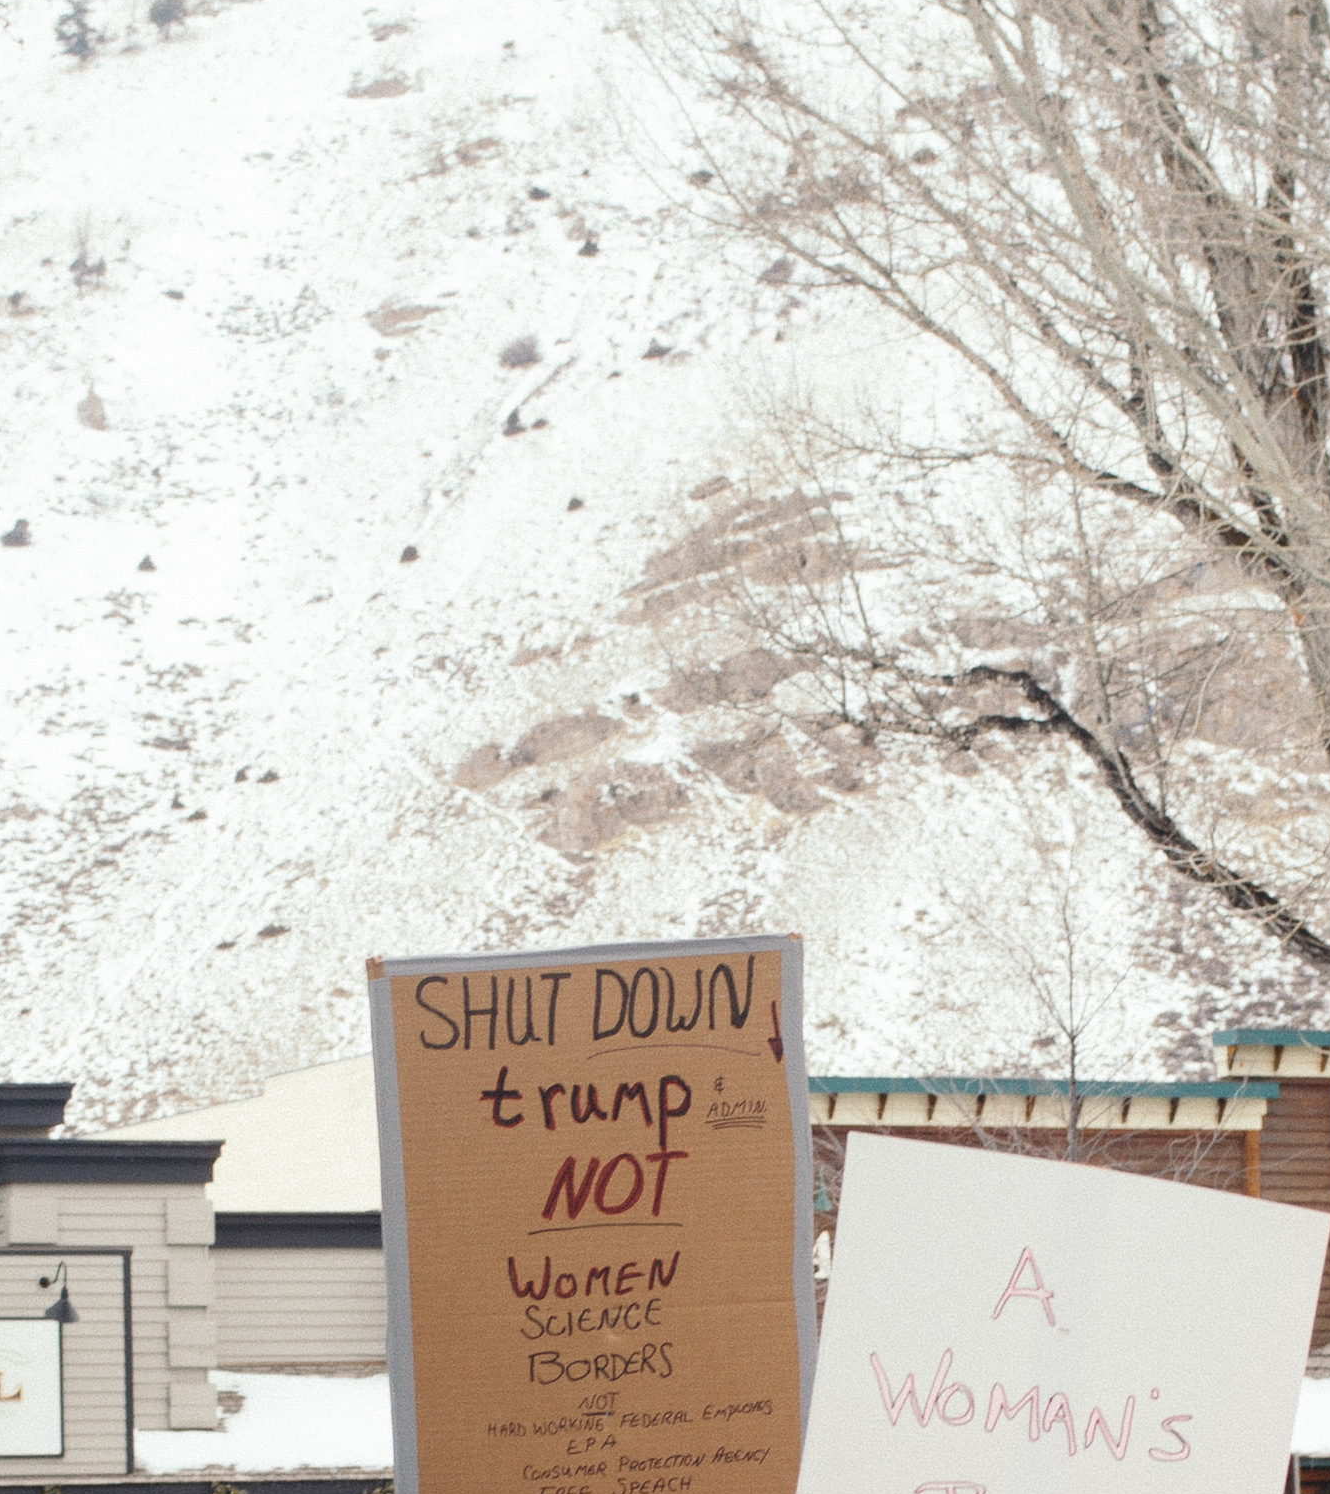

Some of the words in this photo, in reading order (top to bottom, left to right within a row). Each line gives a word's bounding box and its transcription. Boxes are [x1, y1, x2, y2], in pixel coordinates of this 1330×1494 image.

[415, 973, 571, 1050] SHUT
[593, 956, 755, 1041] DOWN
[480, 1066, 692, 1151] trump
[542, 1151, 689, 1220] NOT
[508, 1251, 680, 1300] WOMEN
[991, 1245, 1058, 1328] A
[520, 1298, 662, 1339] SCIENCE
[529, 1342, 674, 1385] BORDERS
[487, 1422, 527, 1437] HARD
[533, 1417, 605, 1435] WORKING
[619, 1410, 693, 1428] FEDERAL
[578, 1392, 620, 1410] NOT
[869, 1347, 1194, 1462] WOMAN'S
[522, 1462, 608, 1481] CONSUMER
[619, 1453, 706, 1472] PROTECTION
